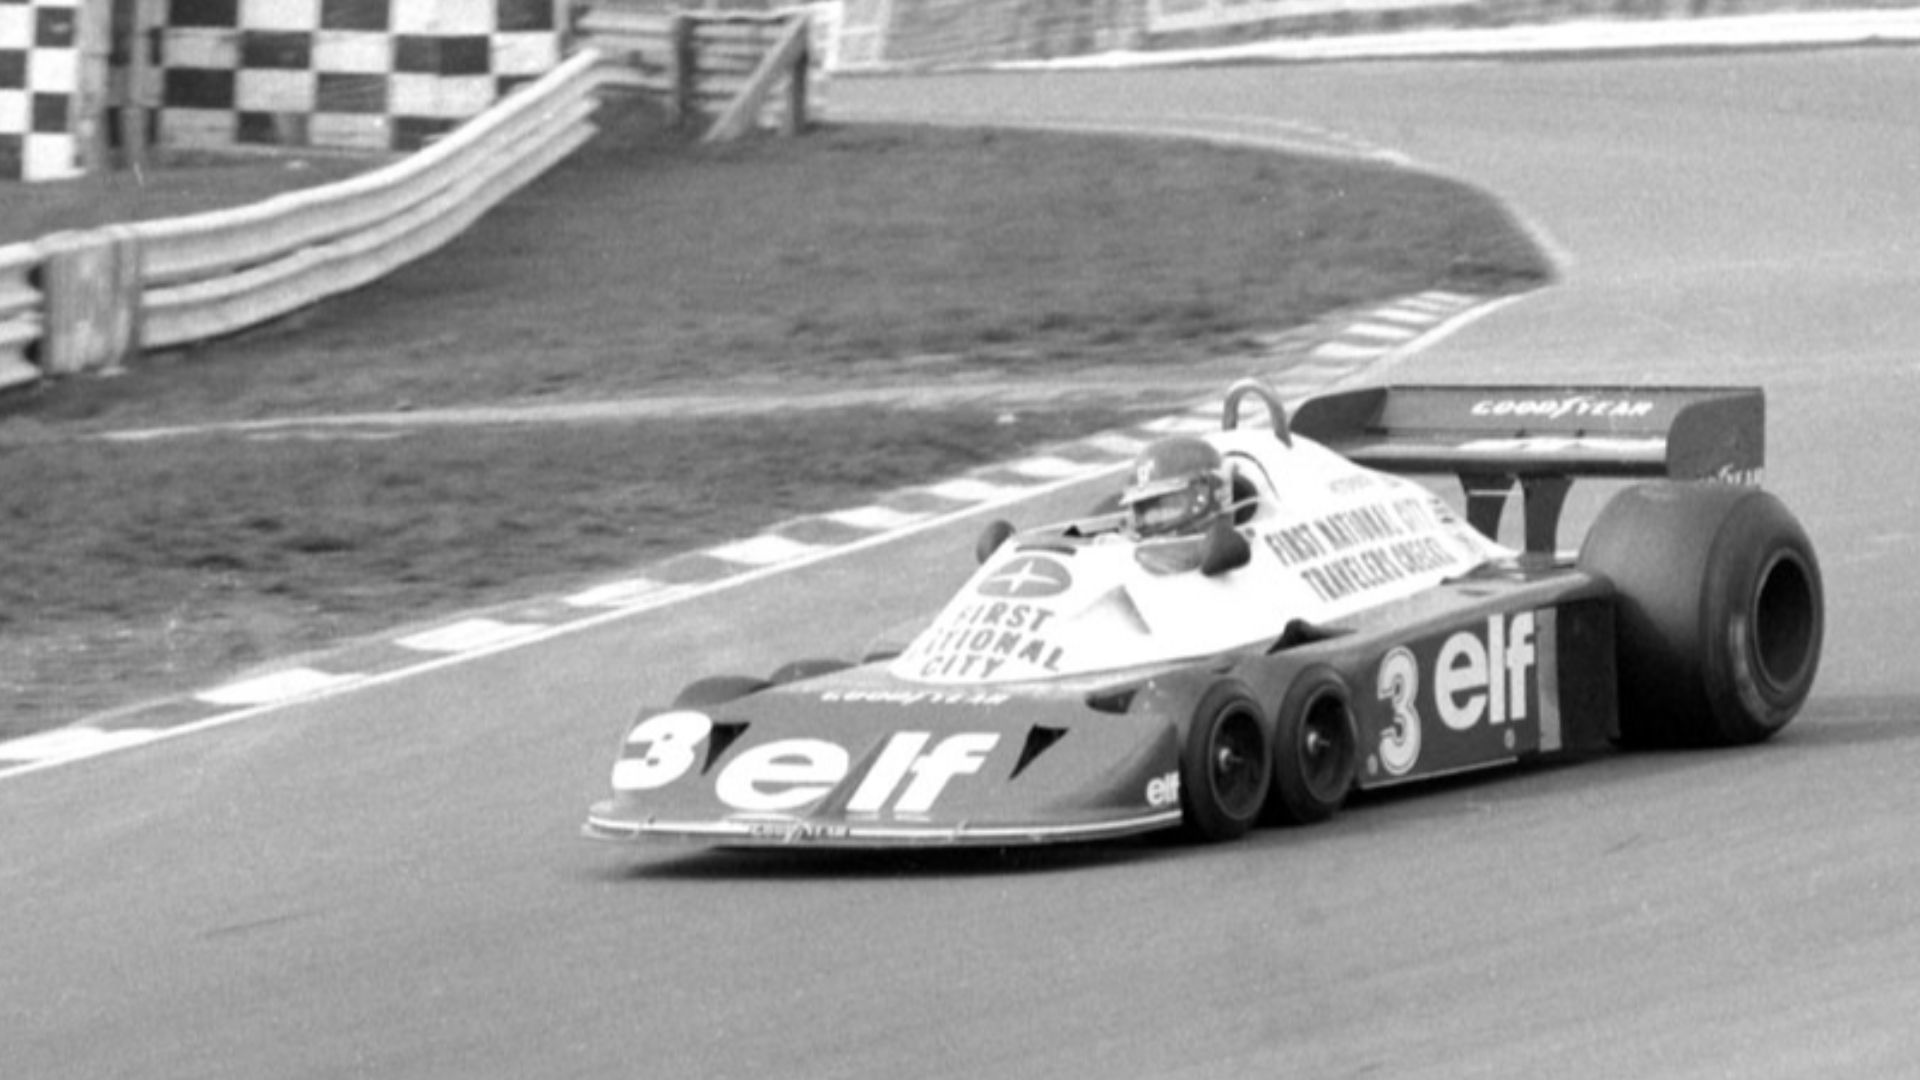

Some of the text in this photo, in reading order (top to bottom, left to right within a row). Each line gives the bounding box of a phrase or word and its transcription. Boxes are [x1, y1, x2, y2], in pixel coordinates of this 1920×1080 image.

[1470, 395, 1653, 419] GOODYEAR
[920, 653, 1005, 679] CITY
[1434, 611, 1535, 731] elf
[612, 710, 711, 791] 3
[1377, 645, 1422, 776] 3
[715, 731, 1000, 812] elf
[1146, 770, 1181, 807] elf
